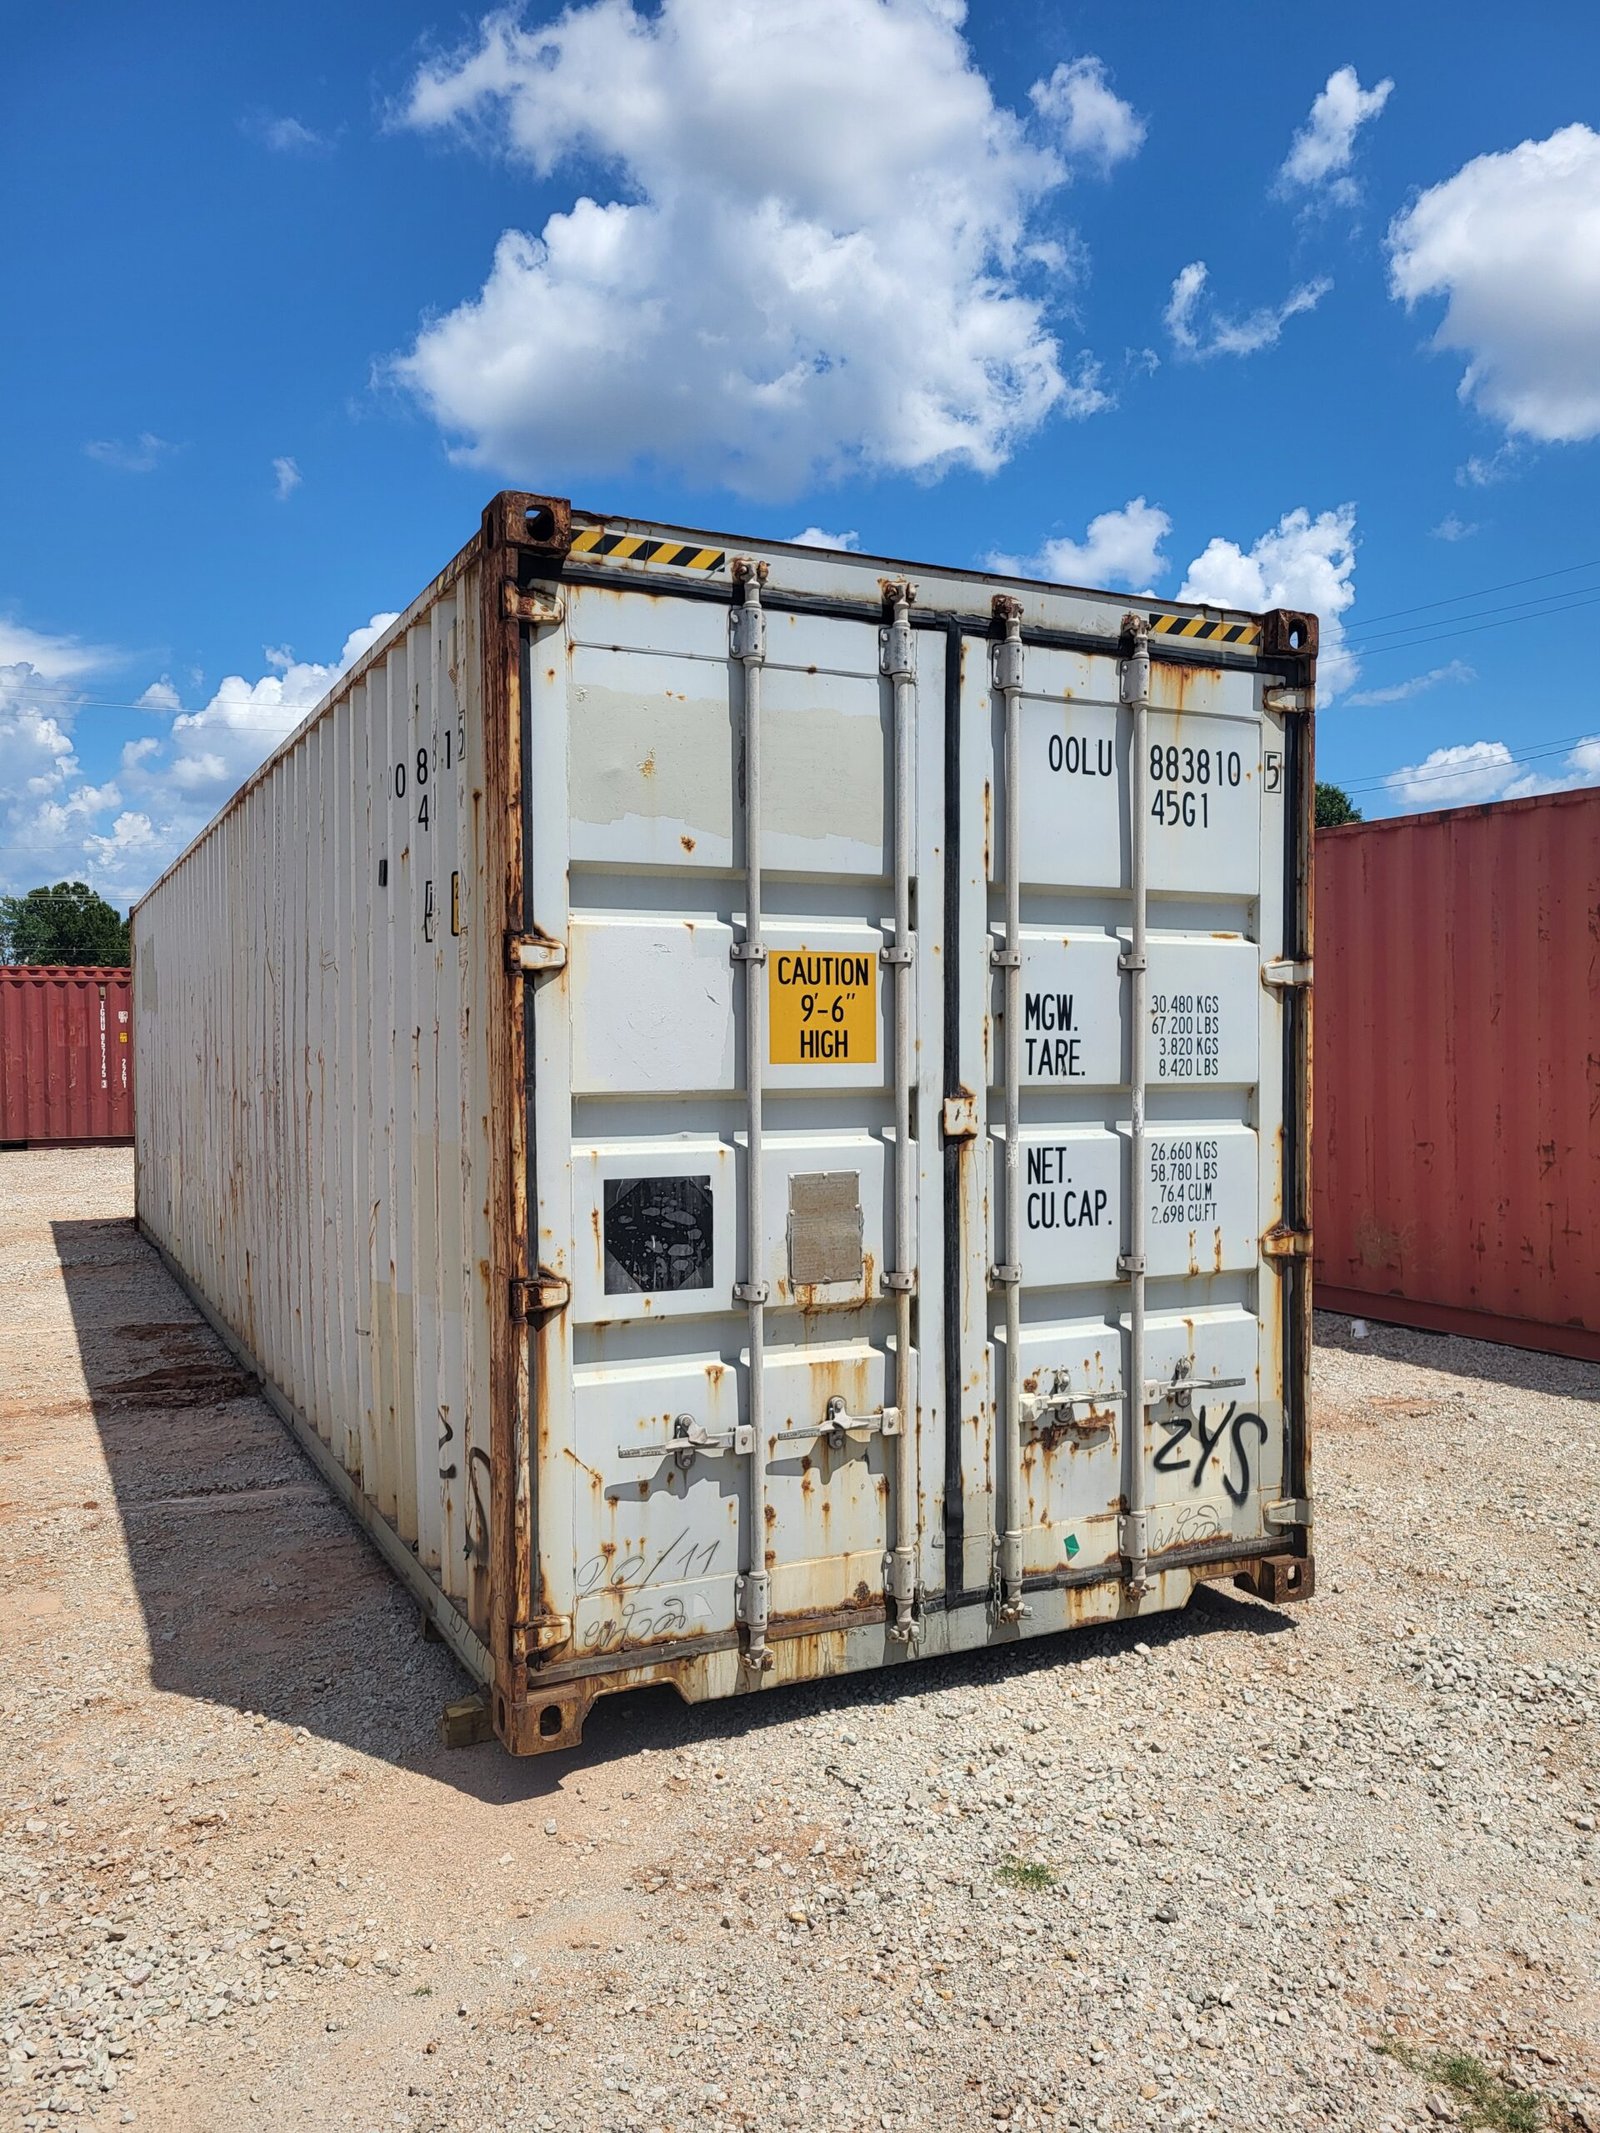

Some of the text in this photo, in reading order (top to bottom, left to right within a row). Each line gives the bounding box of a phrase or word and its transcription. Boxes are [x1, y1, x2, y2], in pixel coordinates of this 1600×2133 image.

[1150, 744, 1241, 787] 883810
[1266, 753, 1280, 790] 5
[1151, 789, 1208, 828] 45G1
[777, 956, 869, 986] CAUTION
[1025, 993, 1078, 1031] MGW.
[1152, 995, 1219, 1013] 30,480 KGS
[1152, 1016, 1219, 1034] 67,200 LBS
[800, 1030, 848, 1058] HIGH
[1159, 1037, 1219, 1055] 3,820 KGS
[1025, 1038, 1085, 1077] TARE.
[1159, 1058, 1218, 1076] 8,420 LBS
[1151, 1141, 1218, 1161] 26,660 KGS
[1027, 1147, 1072, 1184] NET.
[1151, 1162, 1218, 1182] 58,780 LBS
[1160, 1182, 1212, 1203] 76.4 CU.M
[1151, 1205, 1184, 1224] 2,698
